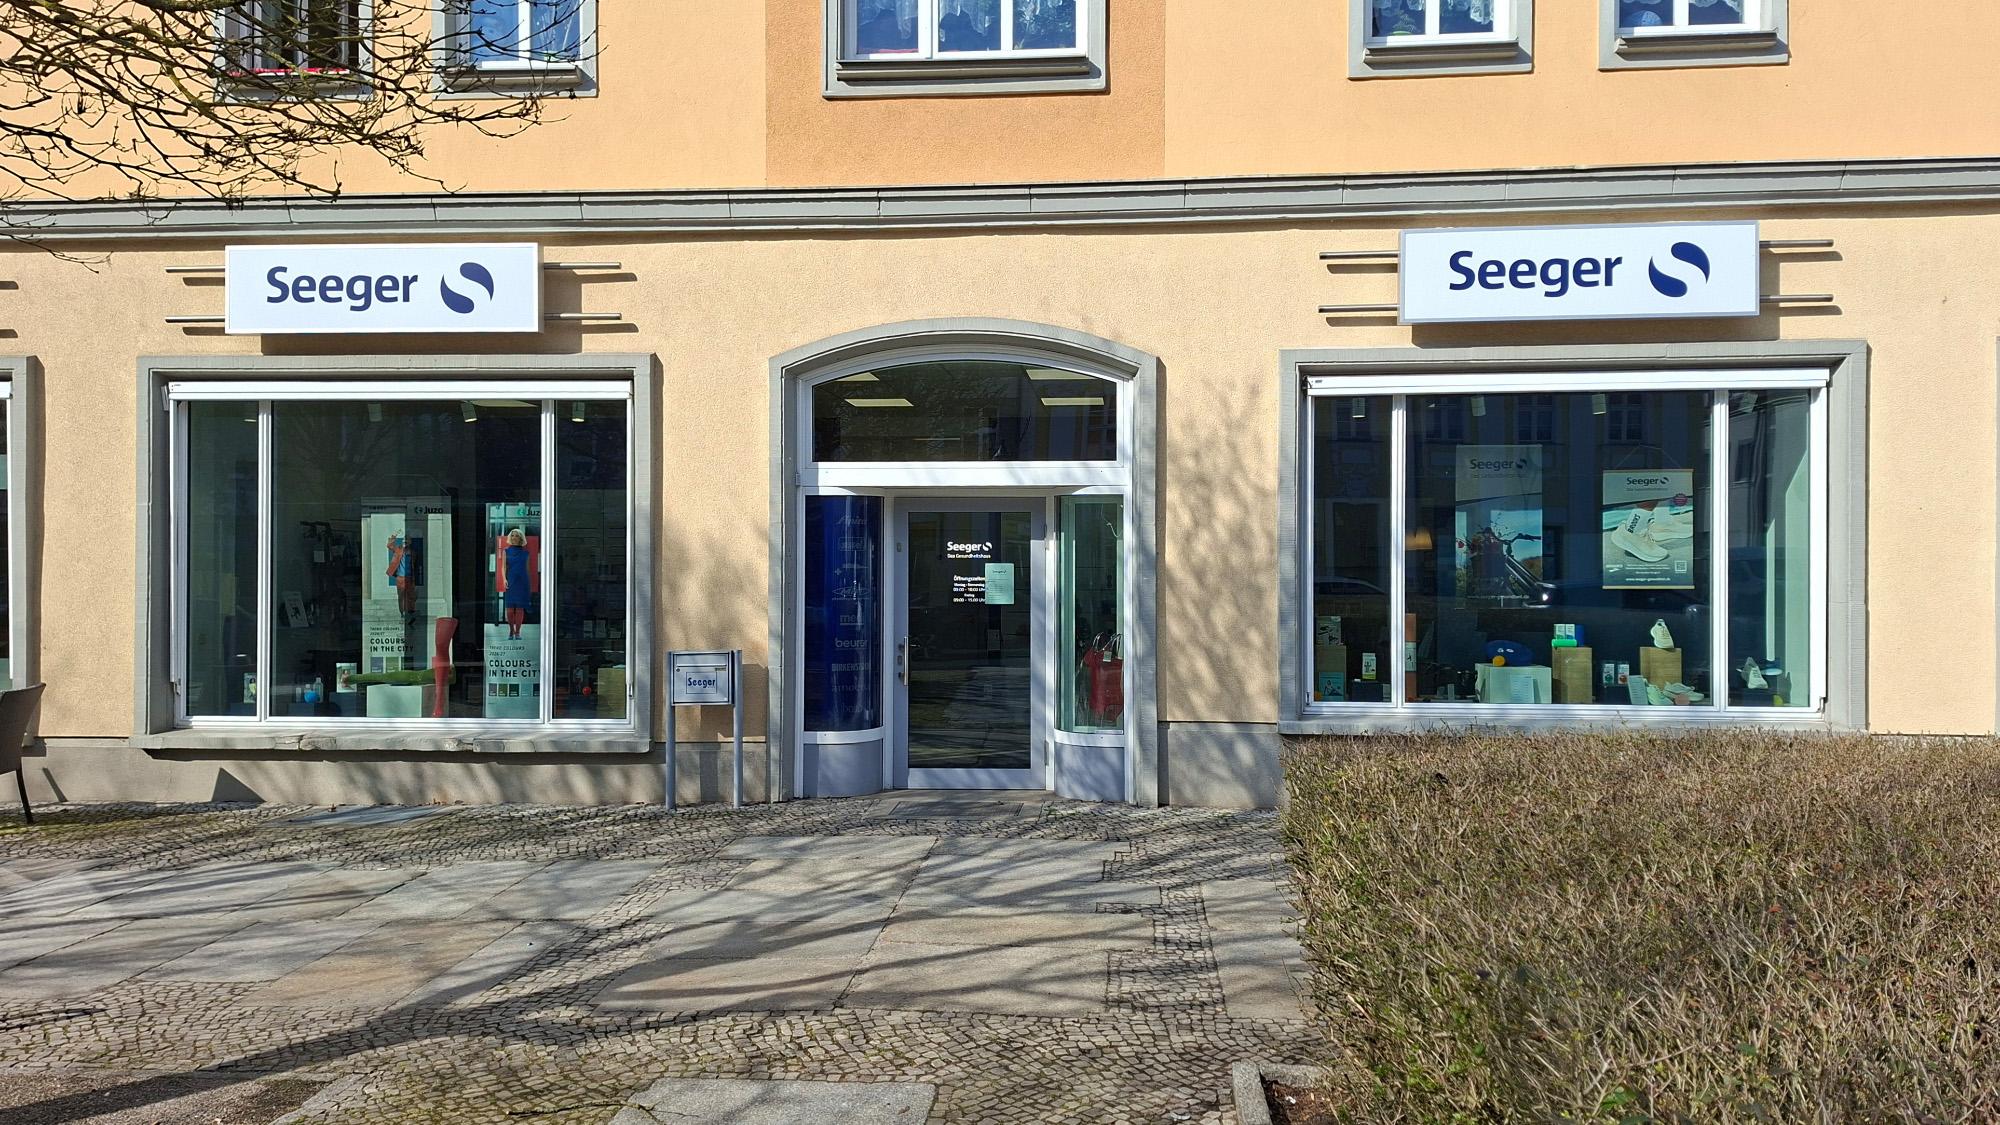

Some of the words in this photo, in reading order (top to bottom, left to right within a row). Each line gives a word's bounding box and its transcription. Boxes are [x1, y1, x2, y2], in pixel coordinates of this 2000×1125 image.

[1449, 250, 1622, 297] Seeger
[266, 265, 418, 311] Seeger
[1470, 459, 1513, 471] Seeger
[1626, 476, 1659, 486] Seeger
[424, 506, 444, 514] Juzo
[947, 542, 982, 552] Seeger
[489, 660, 532, 668] COLOURS
[489, 670, 497, 678] IN
[500, 670, 518, 678] THE
[688, 678, 715, 688] Seeger
